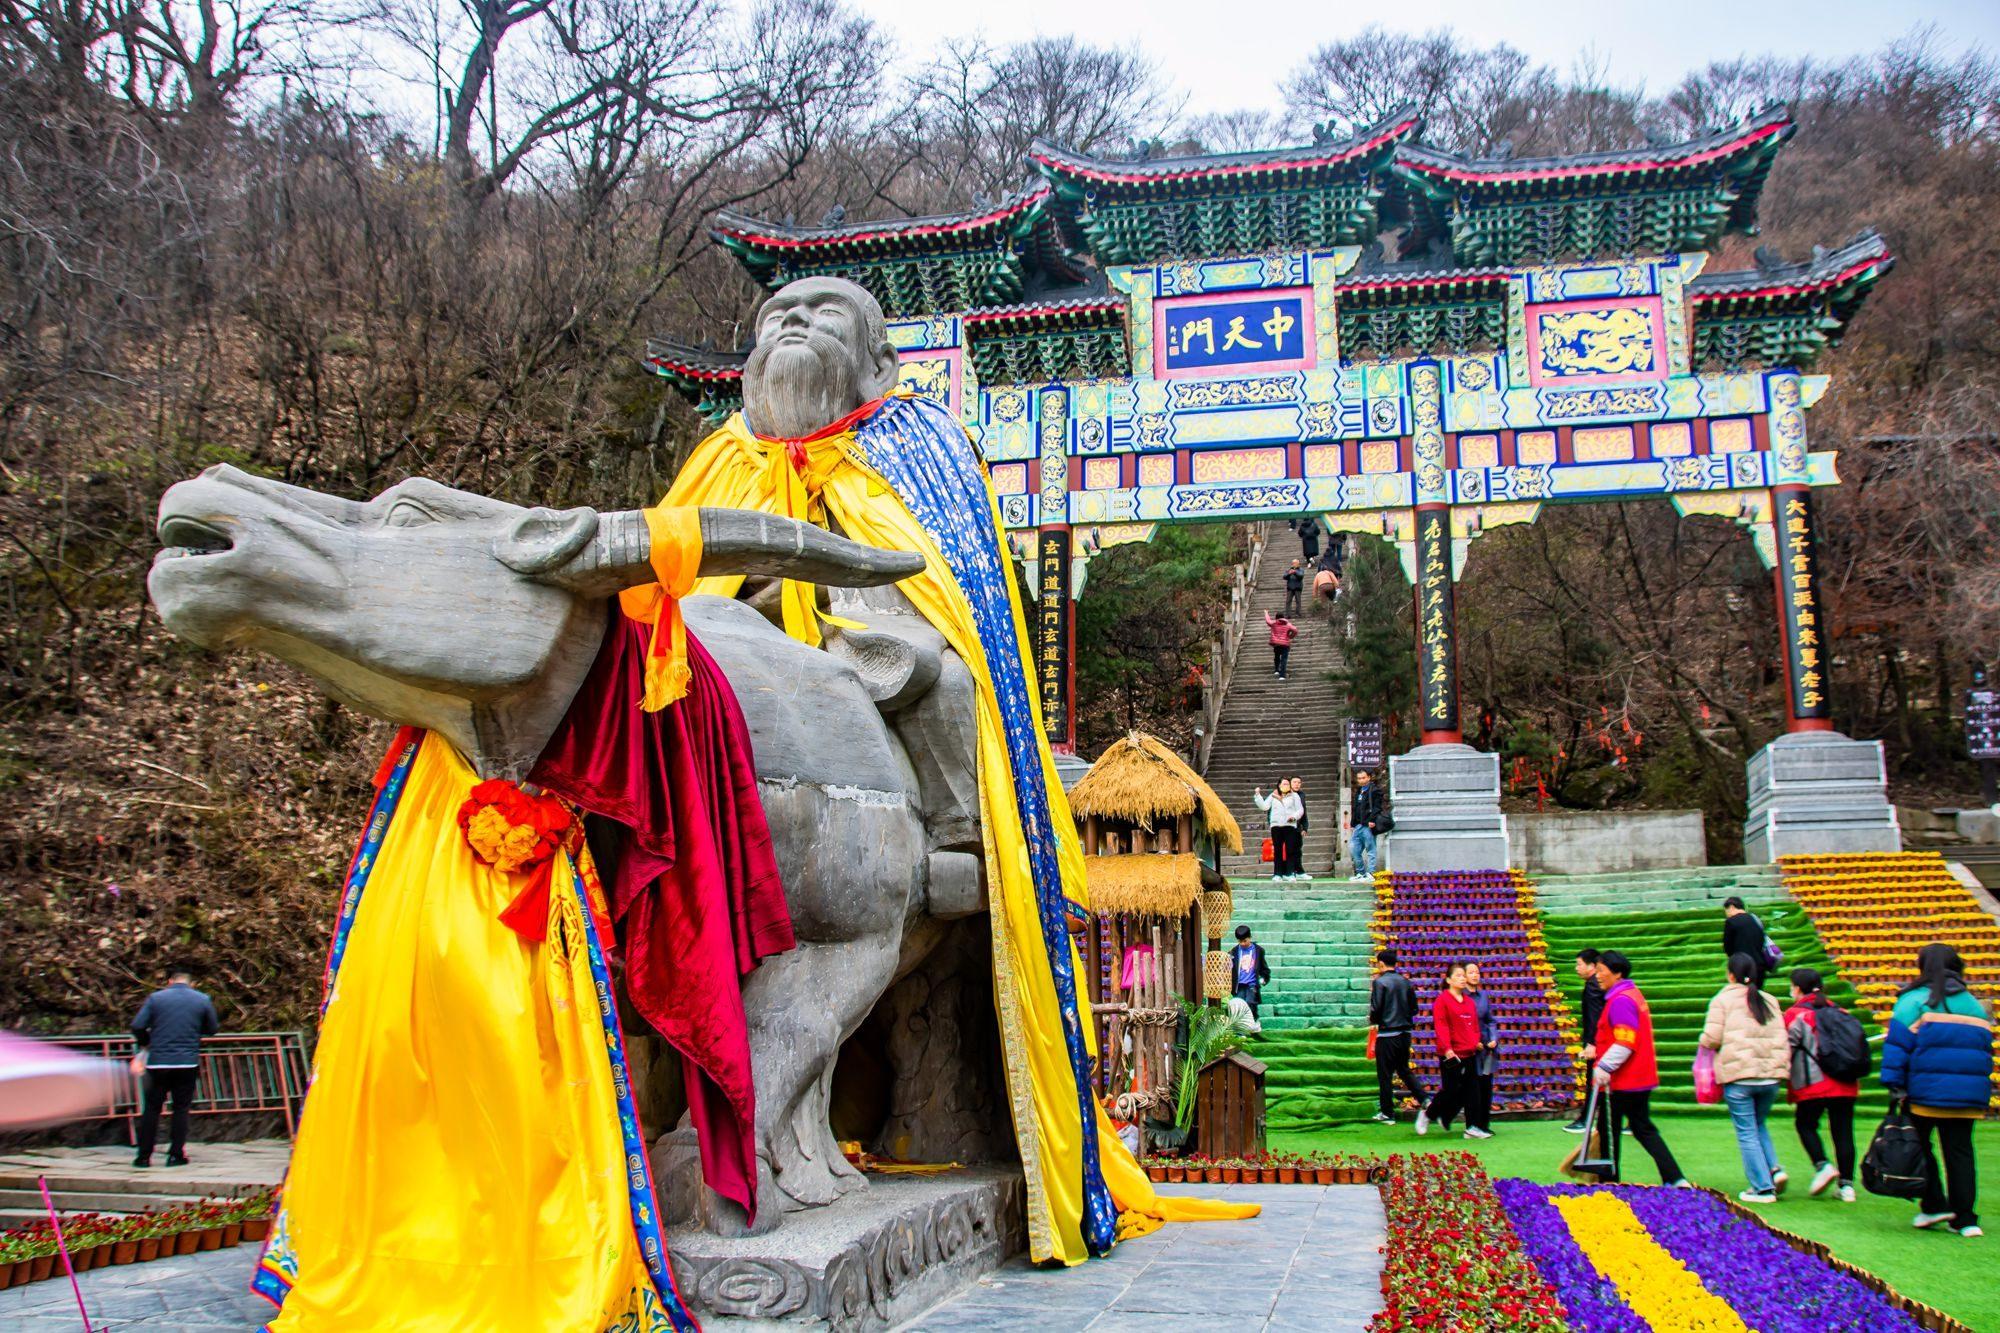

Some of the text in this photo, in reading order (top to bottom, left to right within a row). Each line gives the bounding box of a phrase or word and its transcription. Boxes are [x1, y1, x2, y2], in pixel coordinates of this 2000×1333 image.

[1182, 306, 1294, 355] 中天門
[1043, 540, 1061, 732] 玄門道道門玄道玄門亦玄
